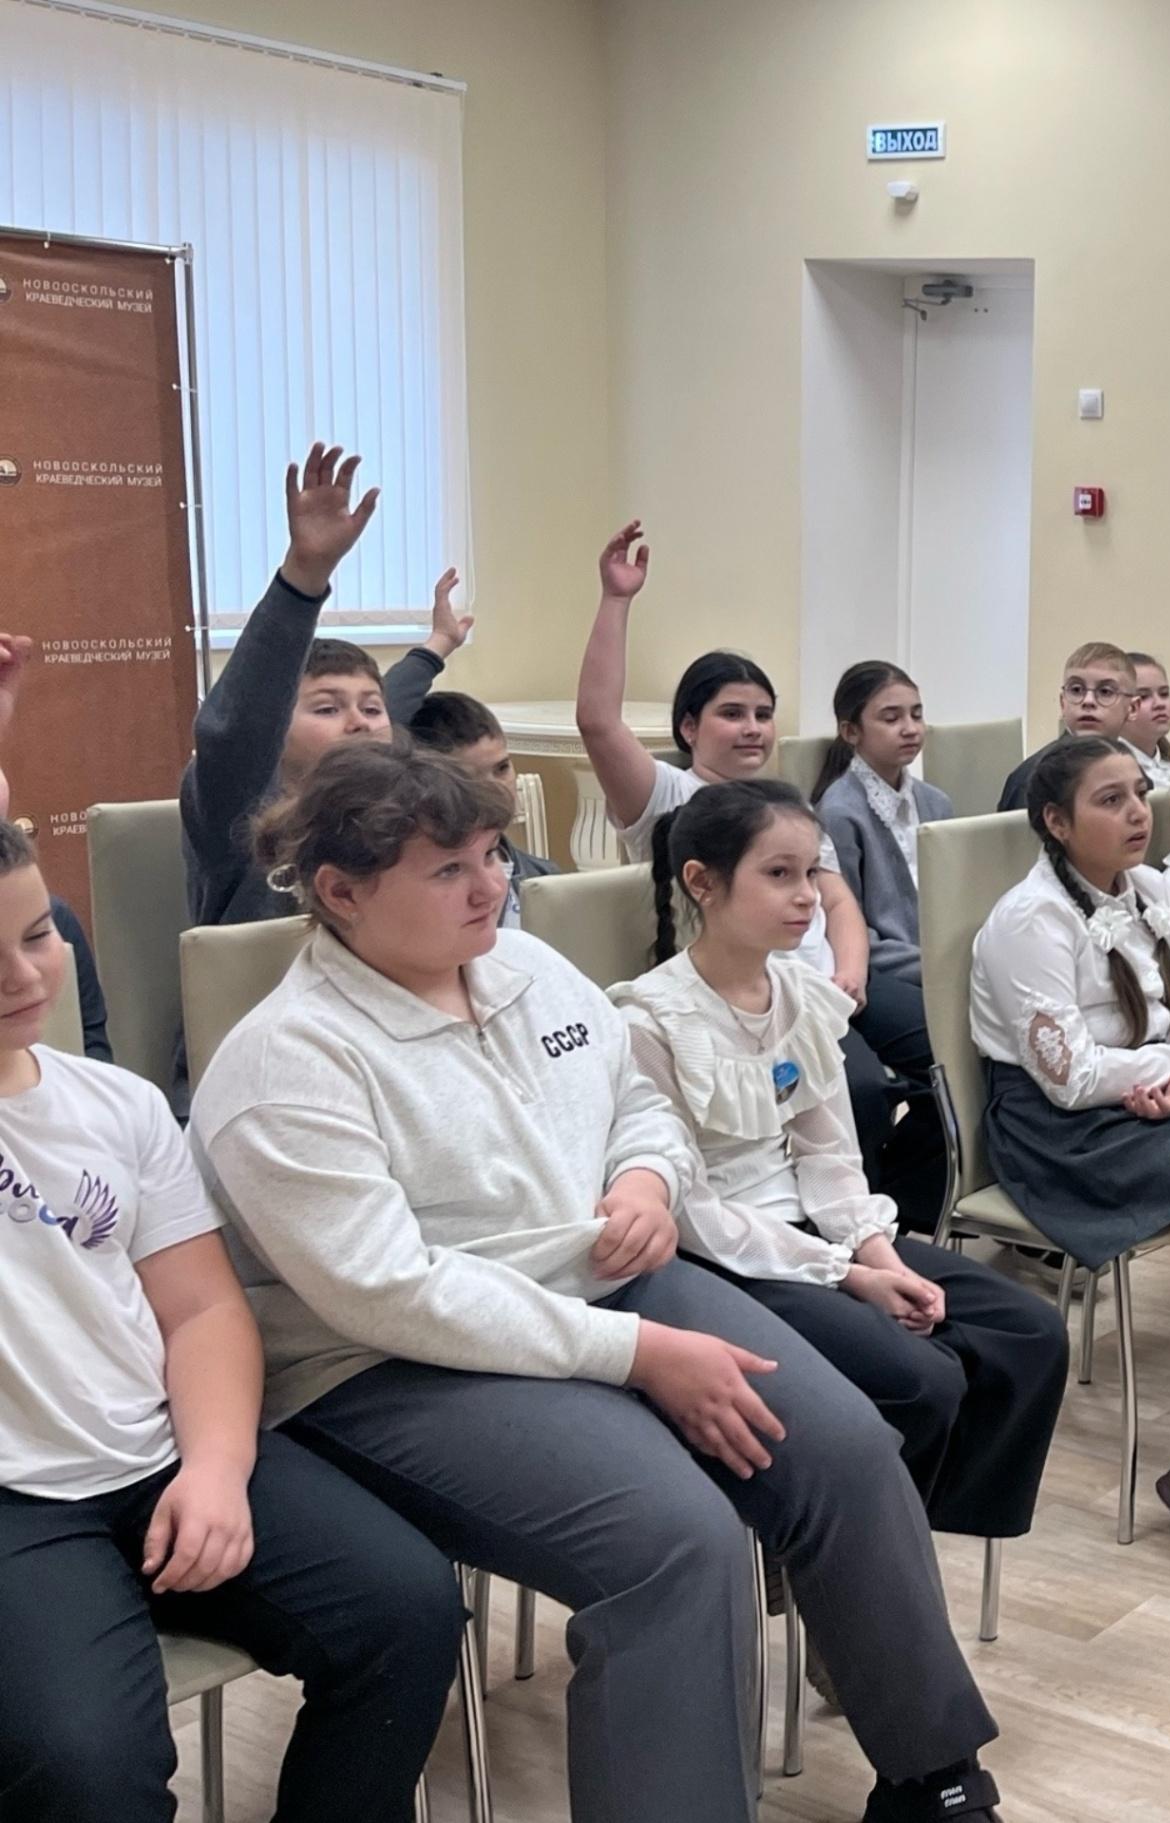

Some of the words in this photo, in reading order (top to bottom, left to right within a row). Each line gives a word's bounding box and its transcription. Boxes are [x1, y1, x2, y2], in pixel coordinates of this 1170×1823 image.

[874, 130, 937, 153] ВЫХОД
[22, 278, 154, 300] НОВООСКОЛЬСКИЙ
[25, 292, 114, 309] КРАЕВЕДЧЕСКИЙ
[117, 298, 153, 313] МУЗЕЙ
[33, 460, 163, 474] НОВООСКОЛЬСКИЙ
[35, 473, 123, 486] КРАЕВЕДЧЕСКИЙ
[126, 475, 163, 487] МУЗЕЙ
[41, 637, 172, 651] НОВООСКОЛЬСКИЙ
[44, 651, 132, 664] КРАЕВЕДЧЕСКИЙ
[136, 649, 171, 661] МУЗЕЙ
[540, 1022, 590, 1058] СССР
